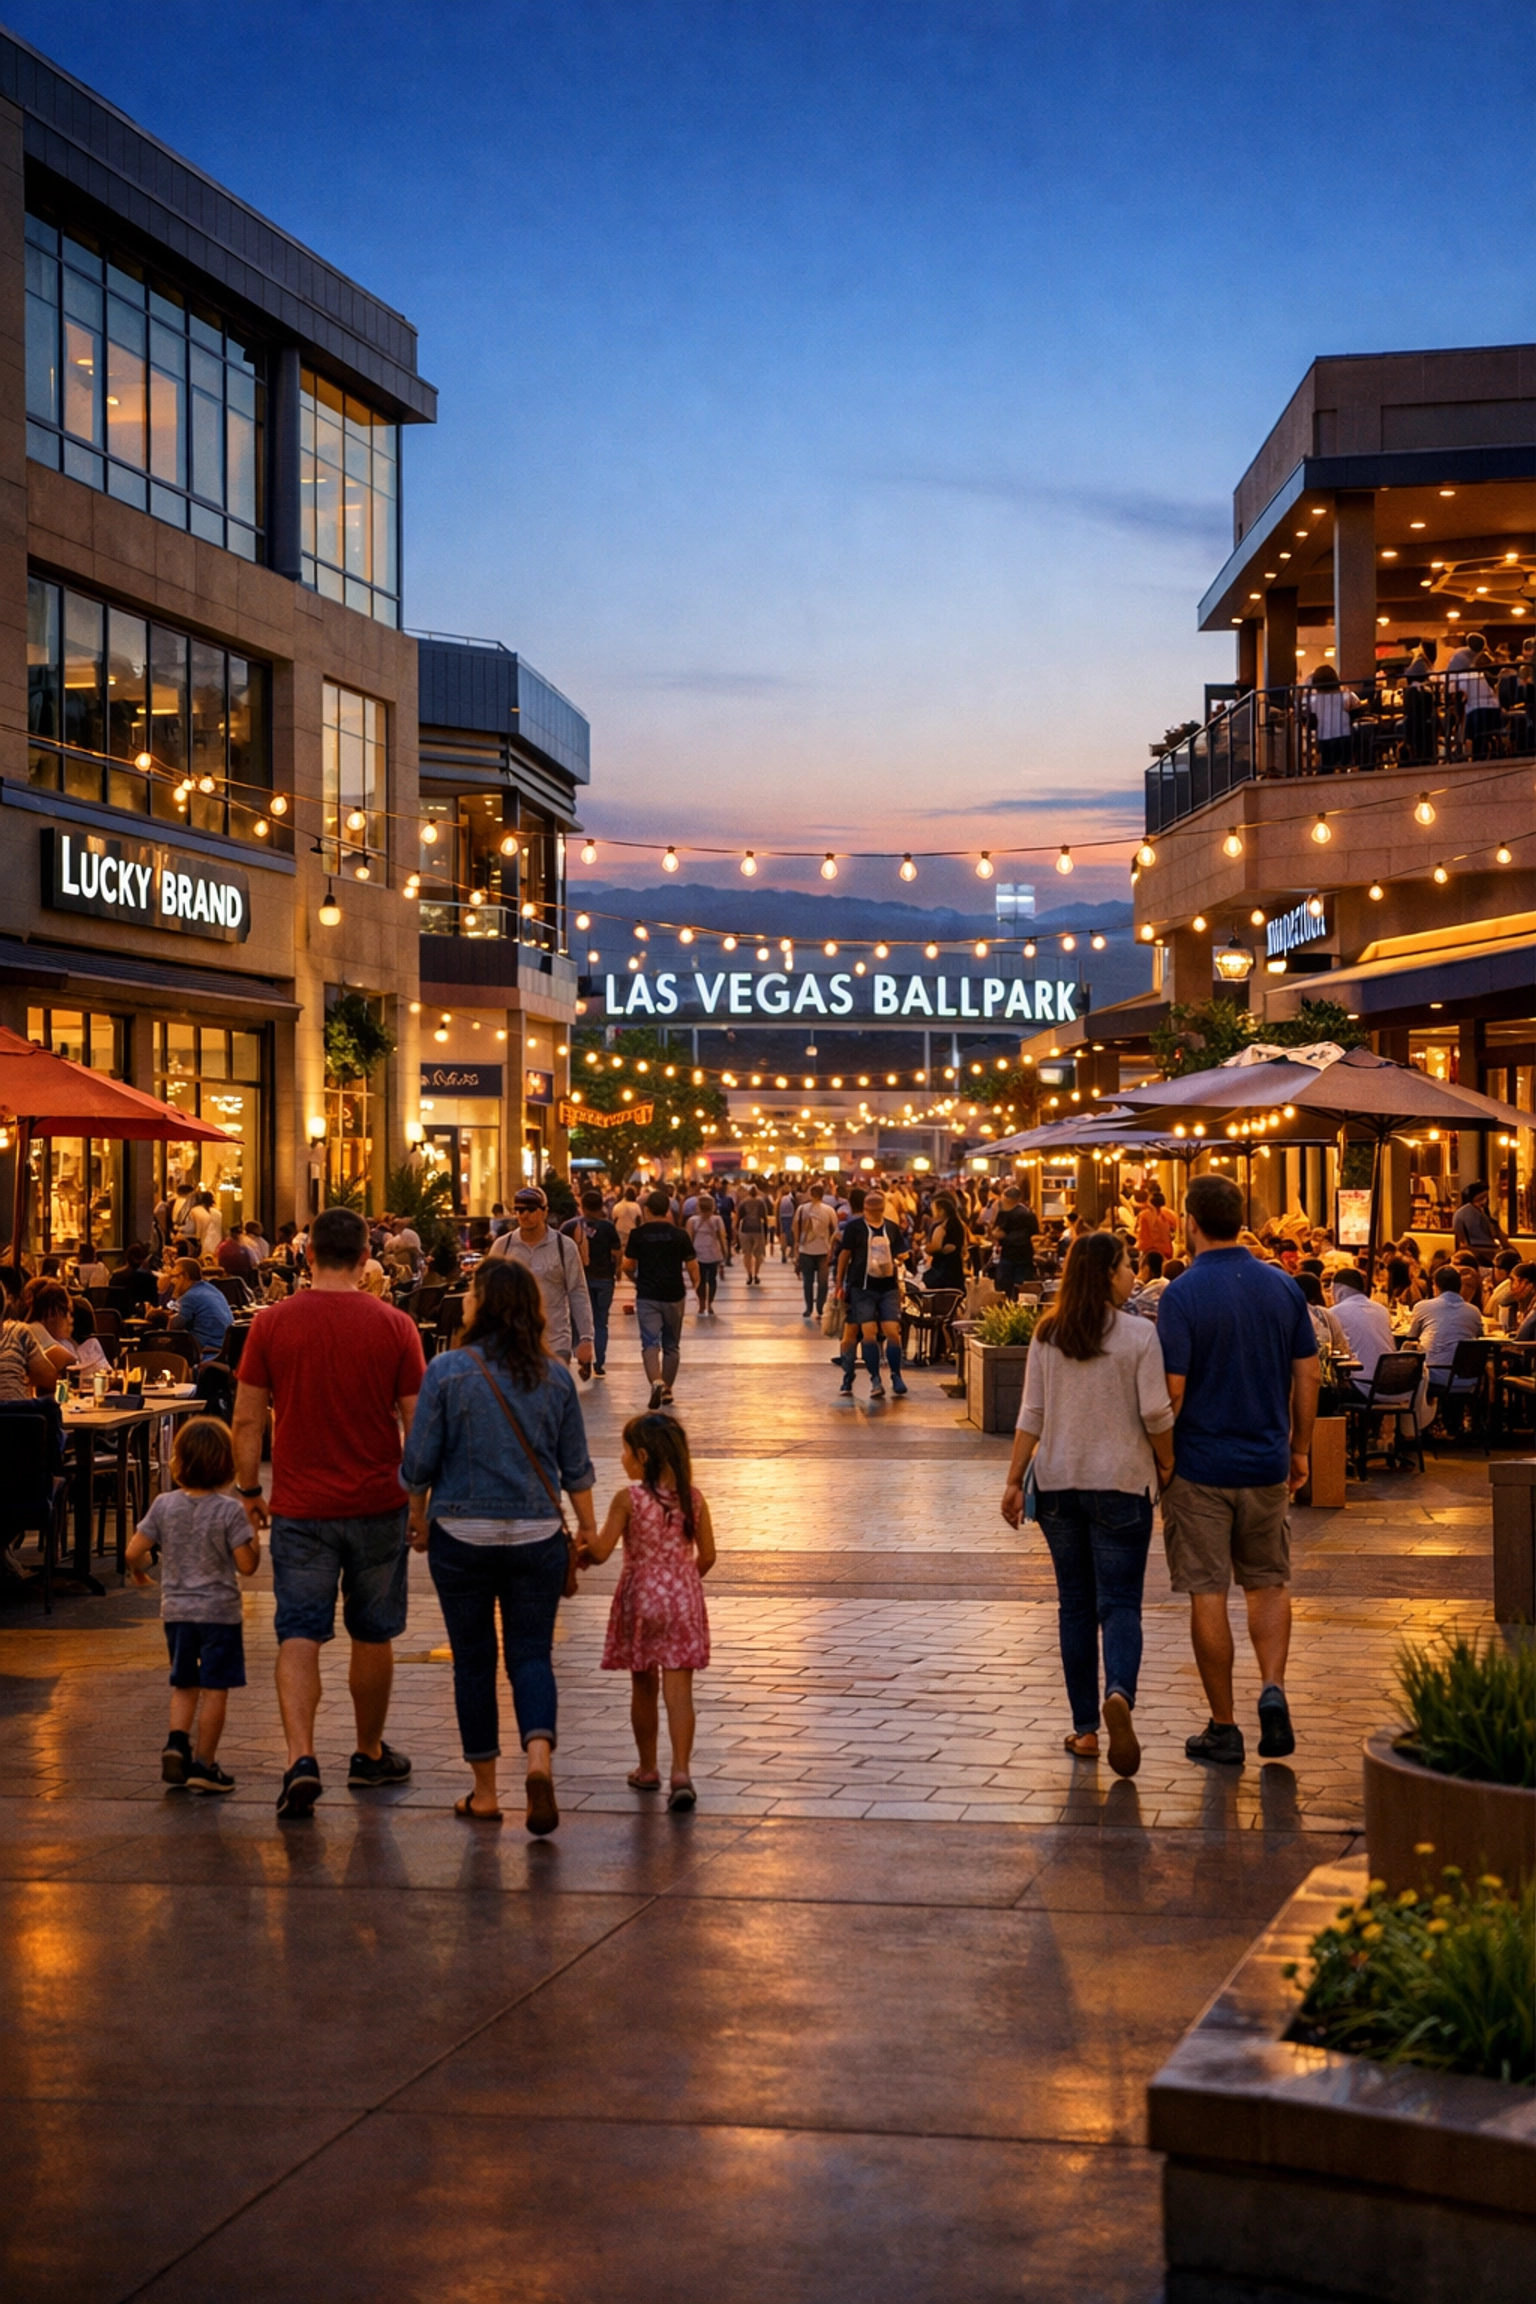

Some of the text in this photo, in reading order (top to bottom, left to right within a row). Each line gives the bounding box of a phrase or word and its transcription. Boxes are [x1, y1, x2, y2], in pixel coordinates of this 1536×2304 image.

[62, 835, 243, 928] LUCKY BRAND
[606, 972, 1078, 1022] LAS VEGAS BALLPARK
